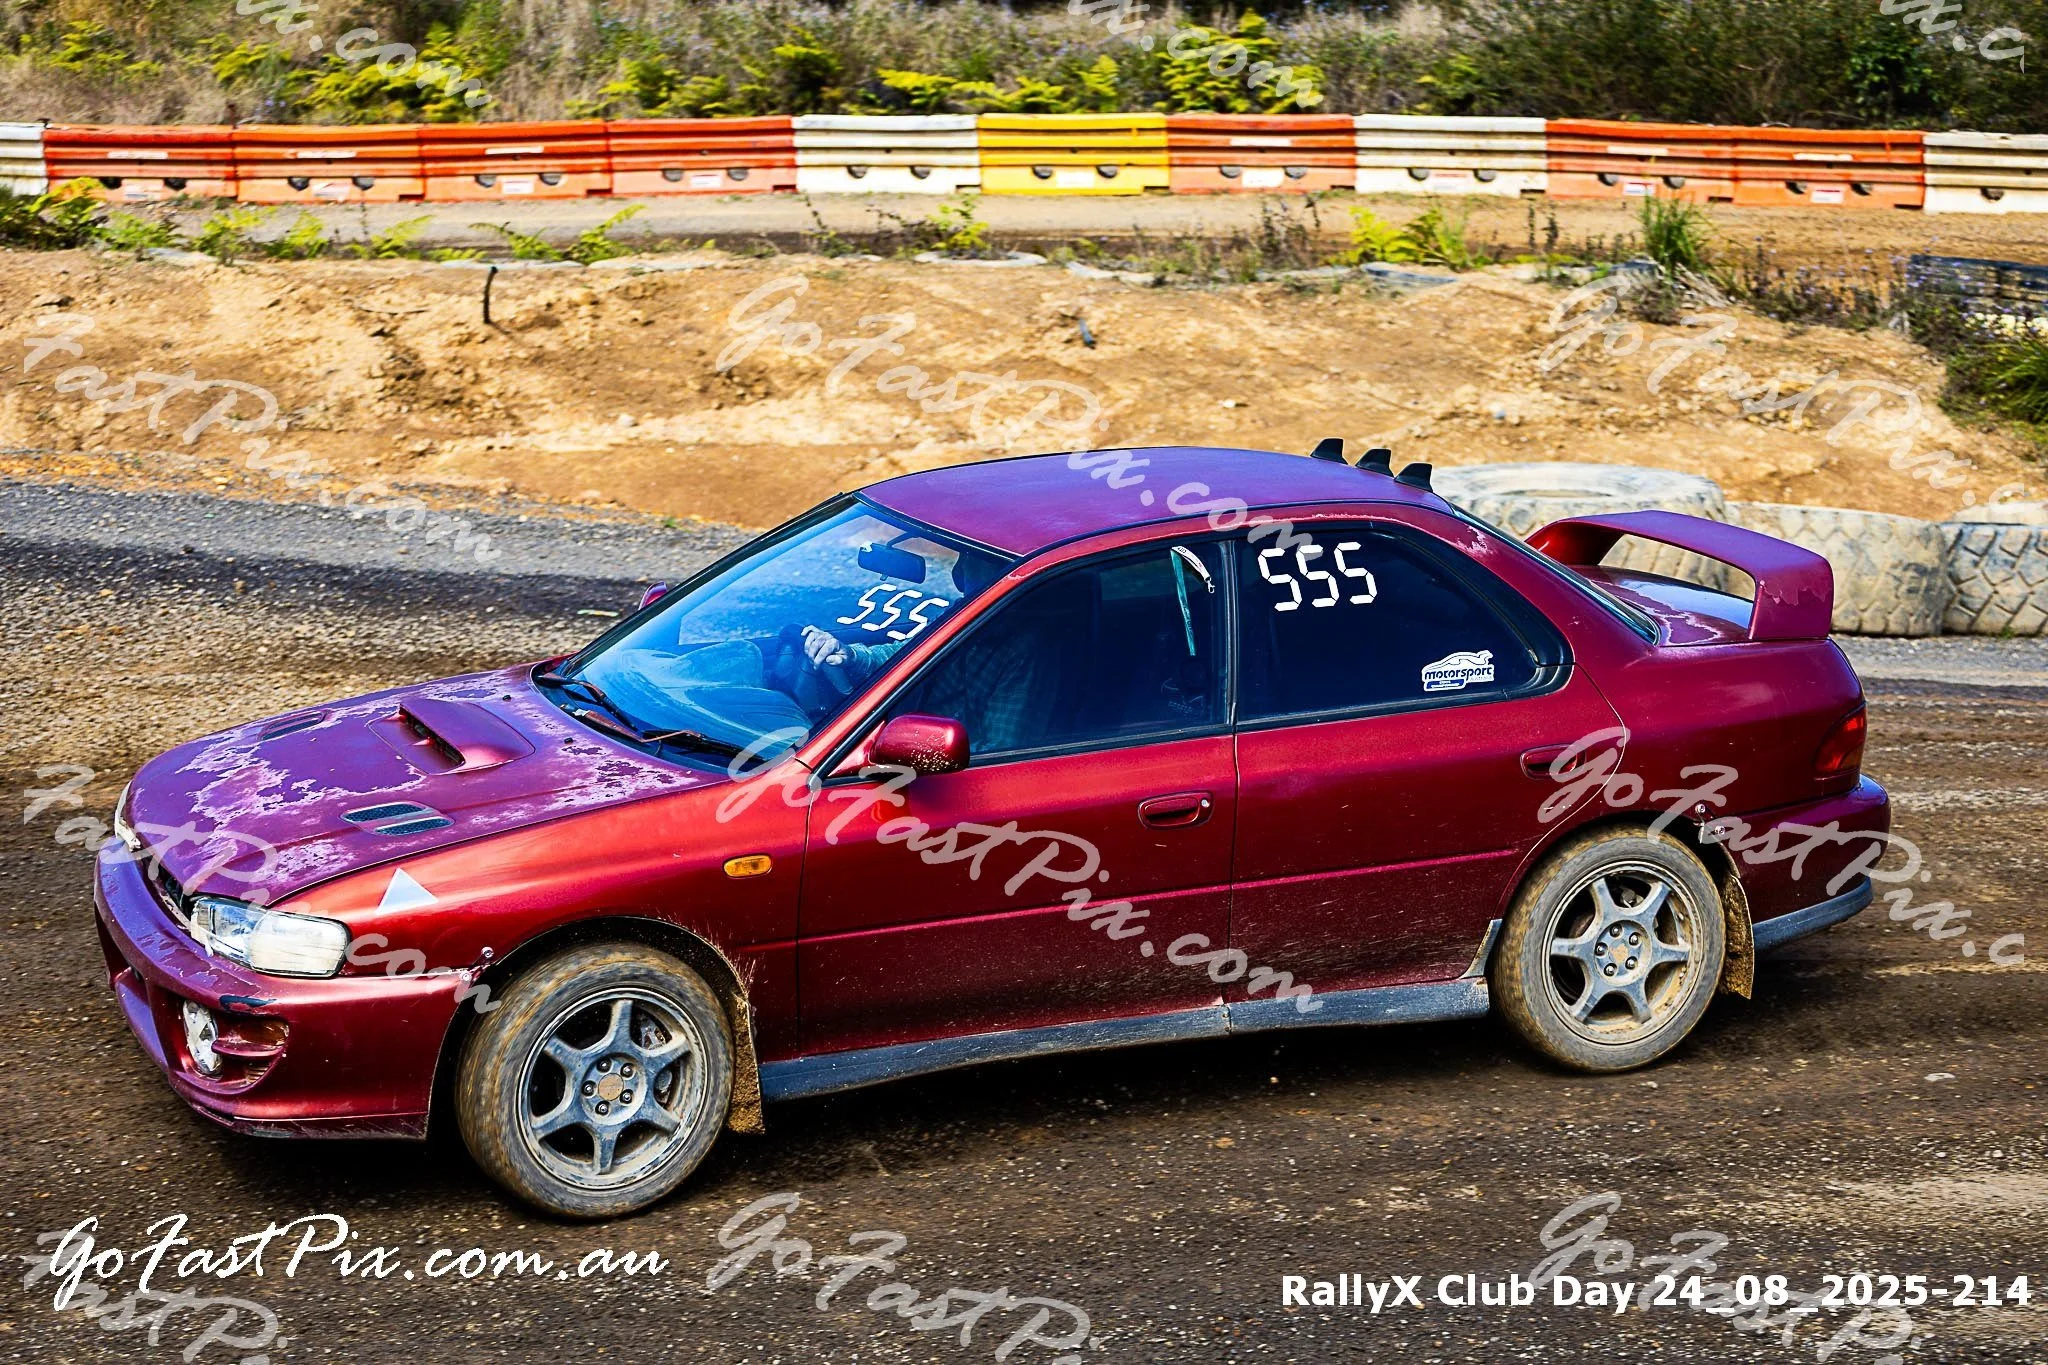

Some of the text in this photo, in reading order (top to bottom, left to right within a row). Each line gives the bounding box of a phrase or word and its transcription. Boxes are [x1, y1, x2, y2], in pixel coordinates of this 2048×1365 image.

[1257, 541, 1378, 612] 555
[836, 583, 950, 641] 555
[1424, 667, 1493, 681] motorsport
